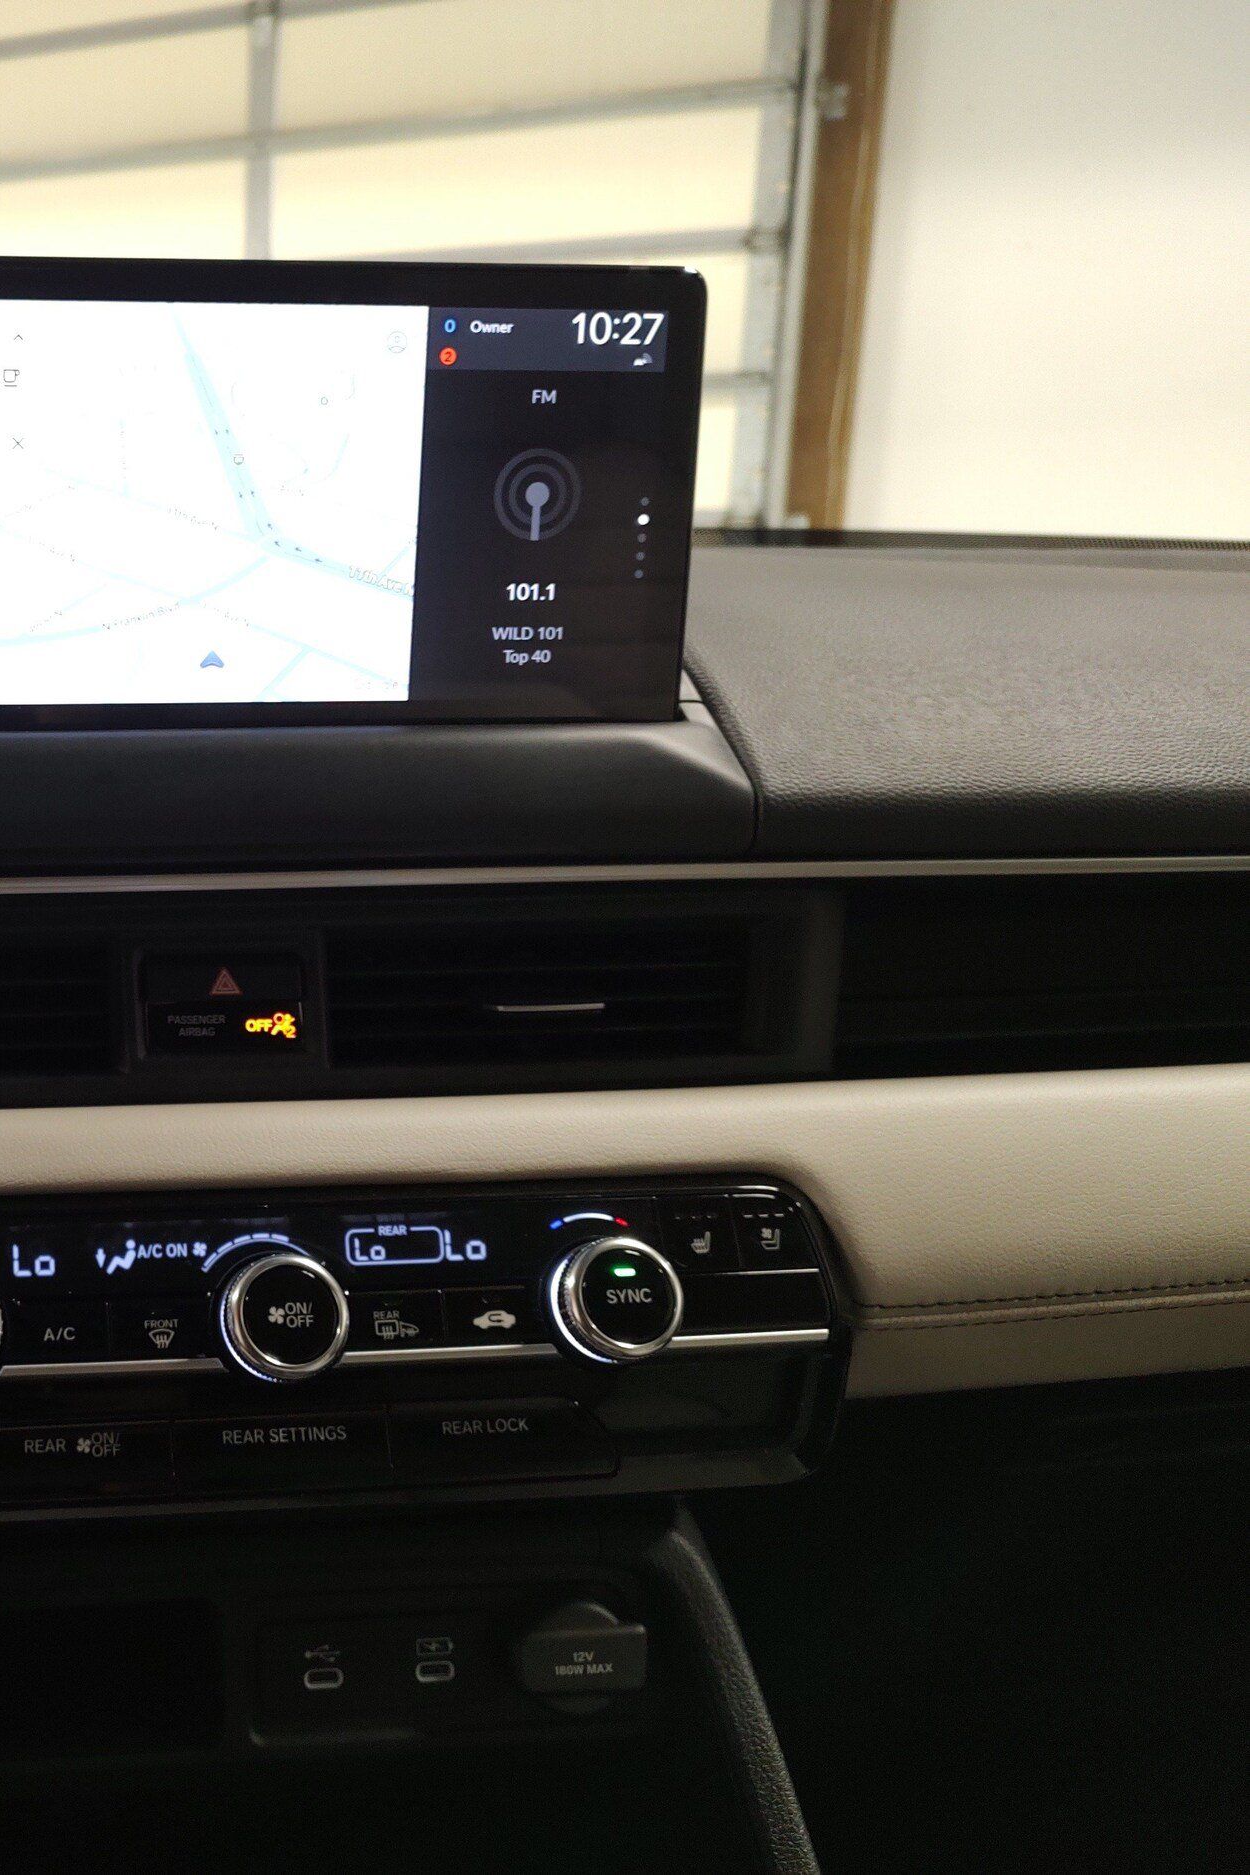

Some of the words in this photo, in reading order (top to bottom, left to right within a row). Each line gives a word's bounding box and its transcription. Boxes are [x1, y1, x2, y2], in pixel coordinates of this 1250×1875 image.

[470, 320, 514, 334] Owner
[571, 312, 665, 345] 10:27
[531, 389, 557, 404] FM
[506, 583, 556, 601] 101.1
[492, 627, 533, 640] WILD
[537, 627, 564, 640] 101
[503, 650, 529, 666] Top
[531, 650, 551, 663] 40
[167, 1015, 226, 1025] PASSENGER
[245, 1019, 272, 1032] OFF
[178, 1027, 216, 1037] AIRBAG
[377, 1225, 408, 1237] REAR
[137, 1245, 162, 1258] A/C
[166, 1243, 188, 1258] ON
[606, 1288, 652, 1304] SYNC
[284, 1302, 313, 1314] ON/
[286, 1315, 314, 1328] OFF
[373, 1310, 400, 1320] REAR
[144, 1319, 178, 1329] FRONT
[44, 1327, 76, 1341] A/C
[440, 1420, 483, 1434] REAR
[487, 1418, 529, 1433] LOCK
[222, 1428, 265, 1444] REAR
[269, 1425, 347, 1443] SETTINGS
[24, 1438, 66, 1453] REAR
[91, 1444, 121, 1457] OFF
[573, 1651, 594, 1662] 12V
[555, 1664, 584, 1675] 180W
[586, 1663, 613, 1674] MAX
